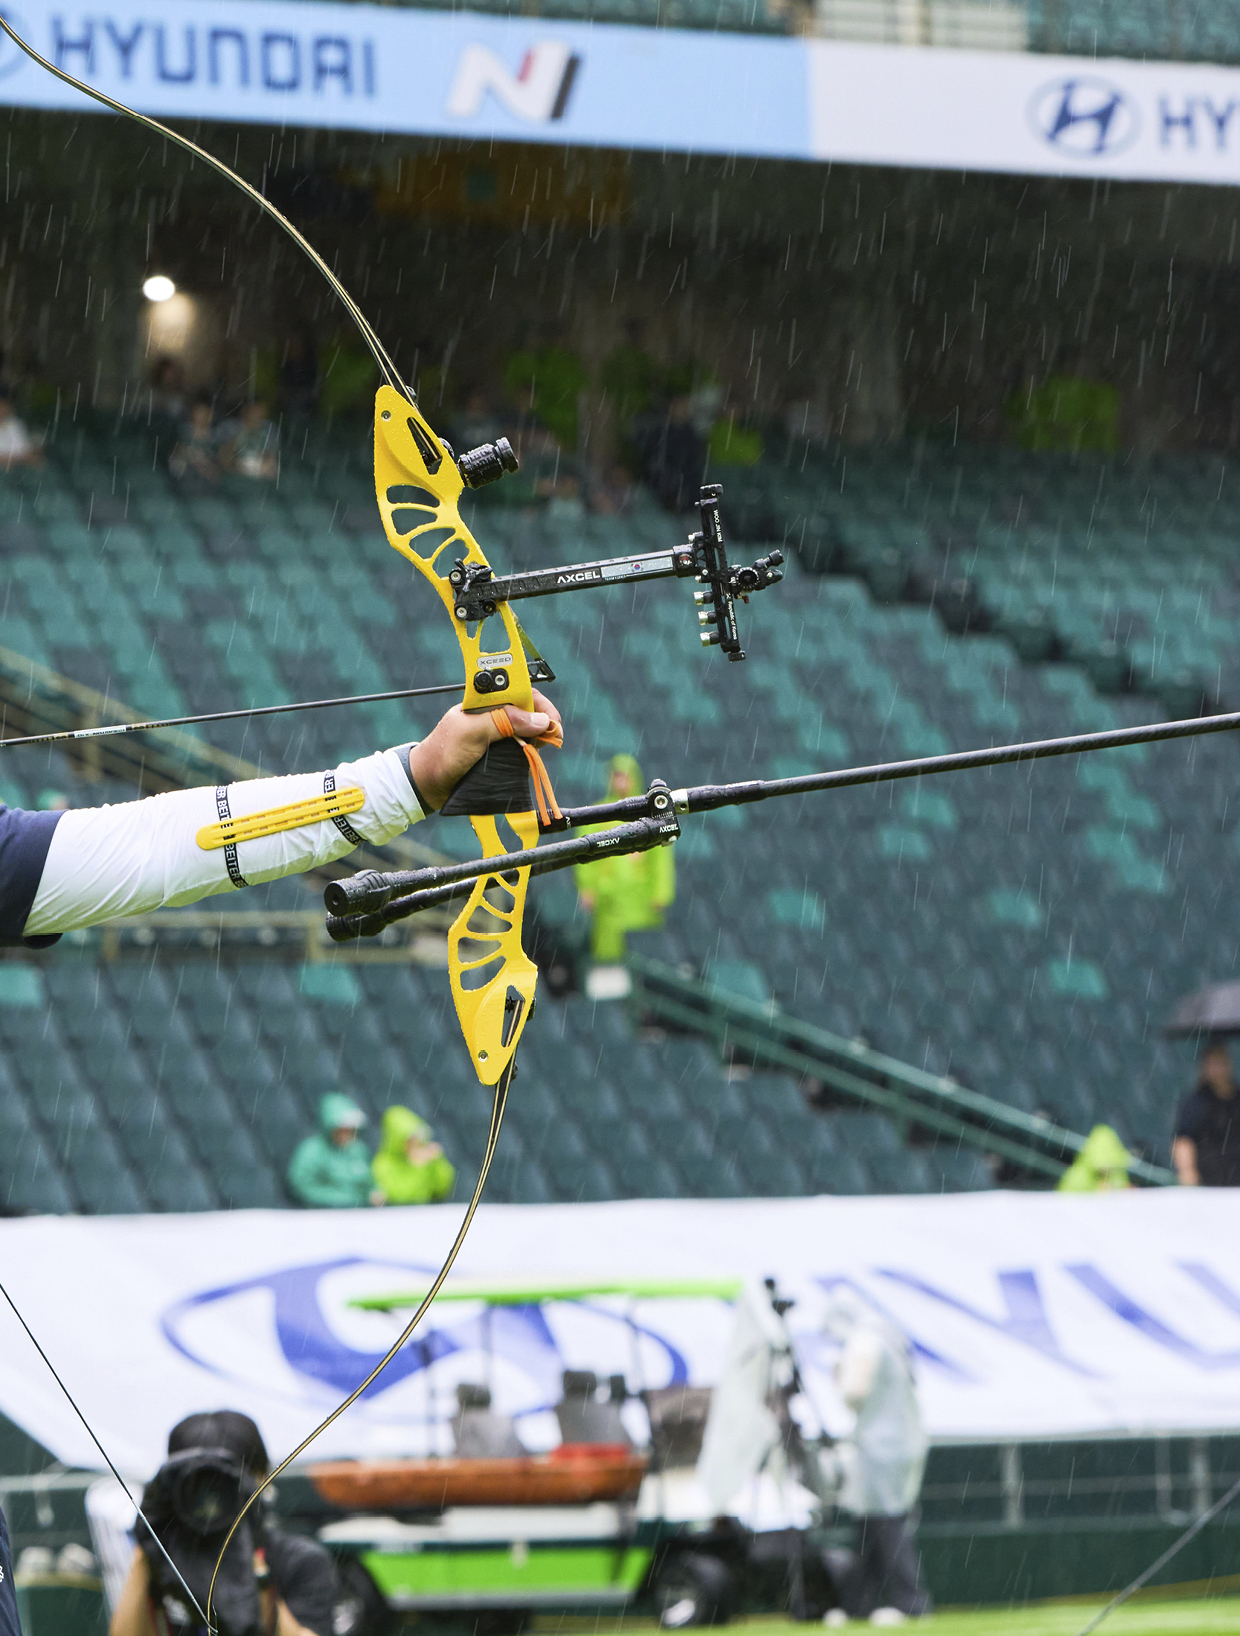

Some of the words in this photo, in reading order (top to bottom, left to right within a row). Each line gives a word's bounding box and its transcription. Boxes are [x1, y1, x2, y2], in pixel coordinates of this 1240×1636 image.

[51, 16, 377, 98] HYUNDAI
[1156, 92, 1240, 152] HY
[556, 570, 601, 584] AXCEL
[480, 656, 512, 665] XCEED
[333, 814, 359, 842] BEITER
